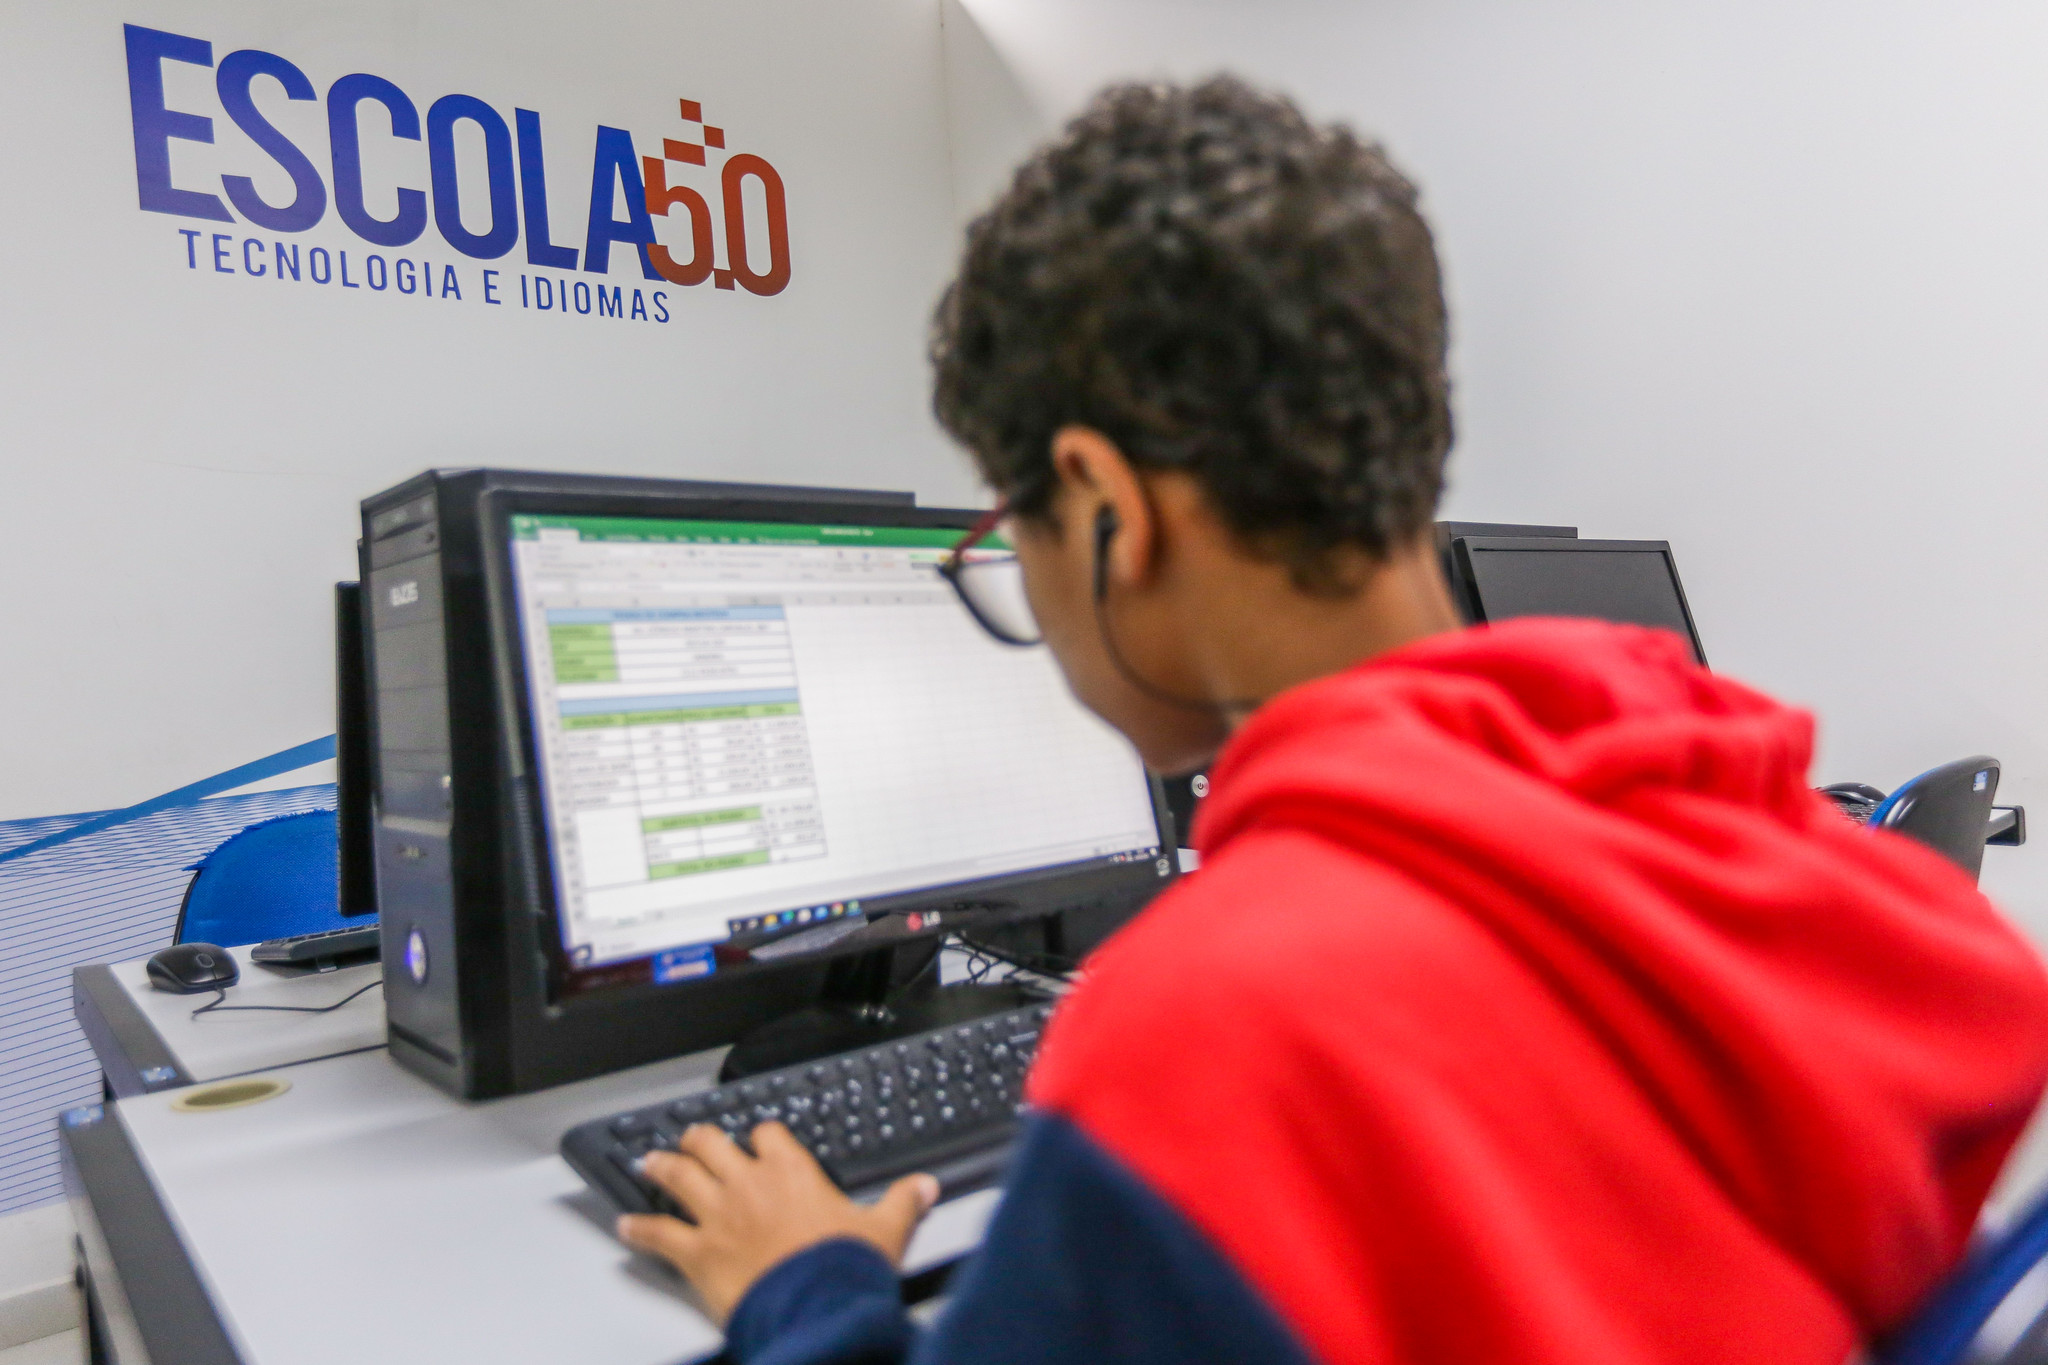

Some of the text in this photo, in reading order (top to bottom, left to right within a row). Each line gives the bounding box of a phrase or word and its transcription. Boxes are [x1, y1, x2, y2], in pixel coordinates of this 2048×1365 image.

[122, 22, 792, 297] ESCOLA 5.0
[178, 228, 671, 325] TECNOLOGIA E IDIOMAS
